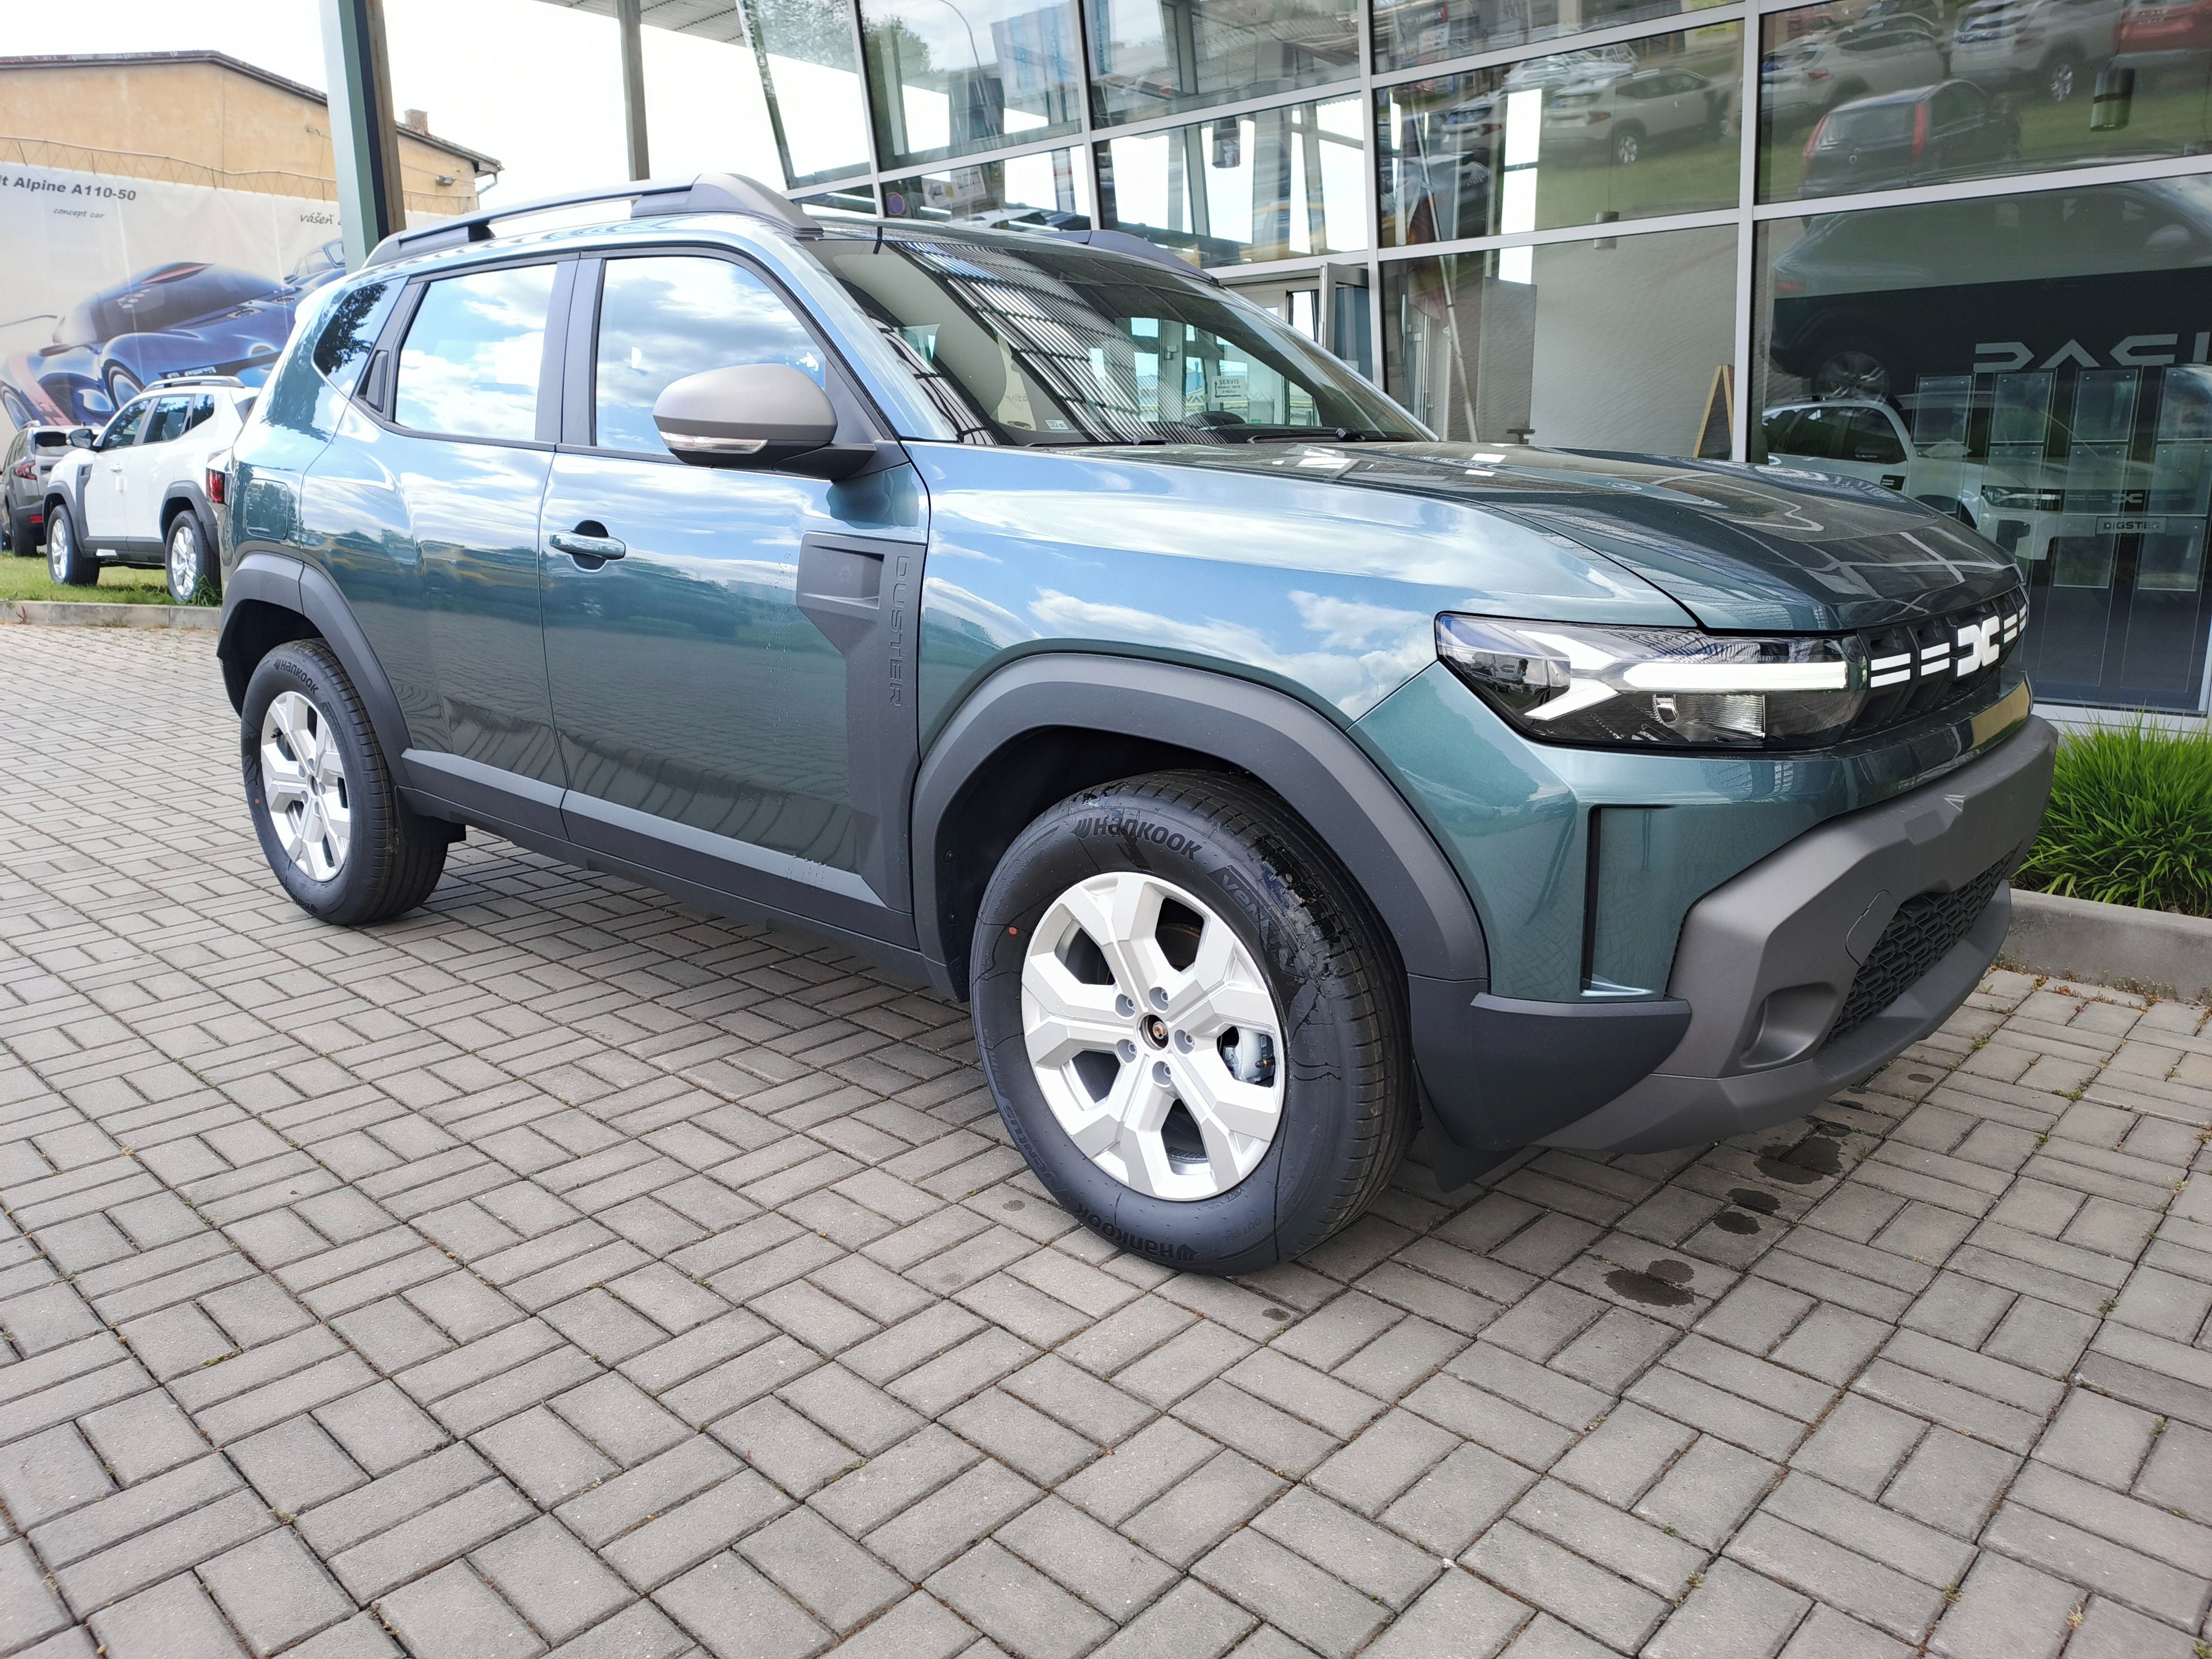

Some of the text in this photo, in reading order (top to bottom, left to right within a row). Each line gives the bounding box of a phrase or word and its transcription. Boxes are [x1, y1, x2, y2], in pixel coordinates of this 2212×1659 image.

[13, 177, 67, 192] Alpine
[71, 184, 137, 201] A110-50
[54, 208, 87, 219] concept
[300, 212, 334, 225] vášeň
[889, 555, 910, 706] DUSTER
